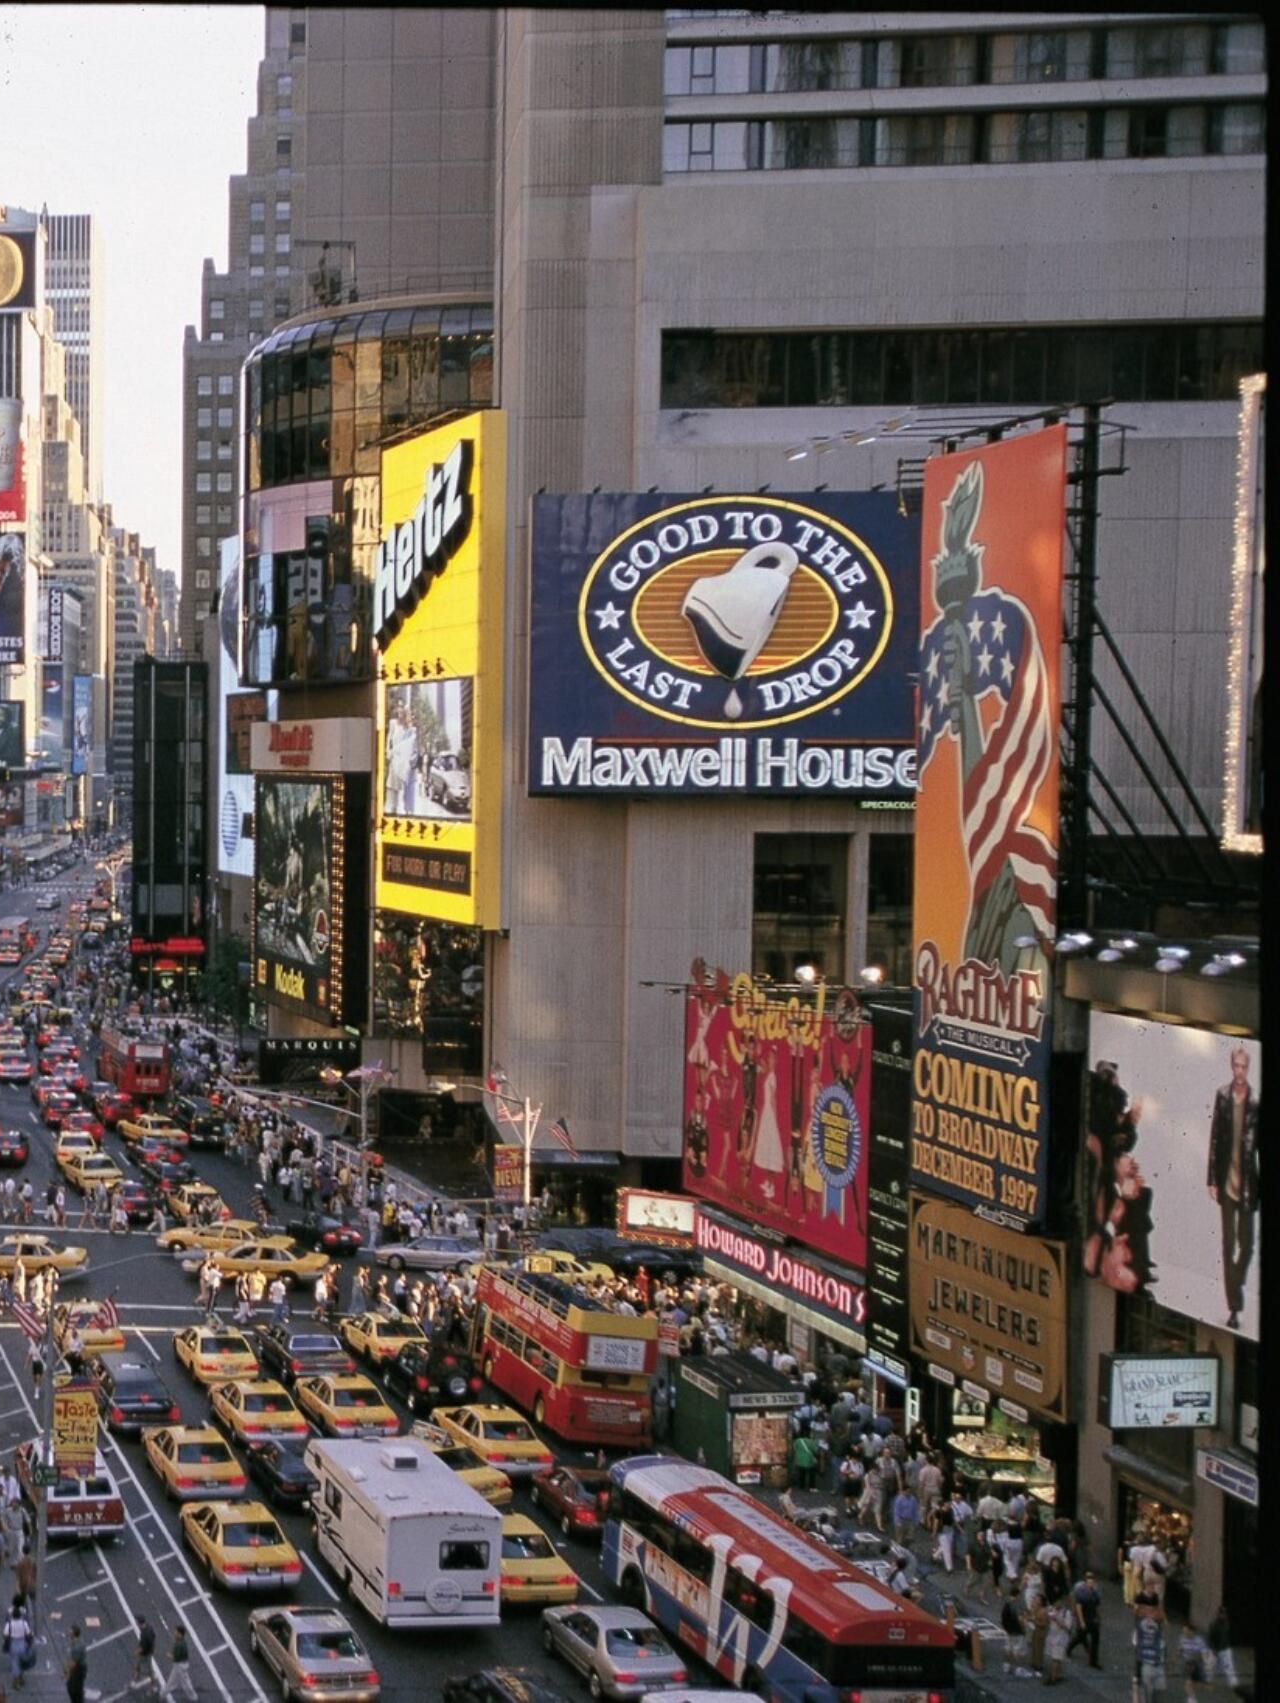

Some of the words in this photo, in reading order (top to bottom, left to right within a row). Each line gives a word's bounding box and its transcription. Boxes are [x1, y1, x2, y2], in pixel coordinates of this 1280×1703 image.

[373, 440, 463, 638] Hertz
[609, 514, 719, 591] GOOD
[724, 512, 782, 544] TO
[793, 520, 868, 594] THE
[605, 638, 701, 710] LAST
[757, 638, 860, 712] DROP
[541, 737, 746, 787] Maxwell
[757, 737, 919, 788] House
[275, 963, 305, 1000] Kodak
[917, 940, 1043, 1037] RAGTIME
[266, 1041, 357, 1050] MARQUIS
[946, 1024, 967, 1043] THE
[969, 1029, 1015, 1056] MUSICAL
[914, 1049, 1040, 1132] COMING
[913, 1101, 935, 1137] TO
[938, 1108, 1039, 1174] BROADWAY
[912, 1139, 995, 1199] DECEMBER
[1000, 1173, 1038, 1214] 1997
[698, 1216, 766, 1271] HOWARD
[766, 1250, 866, 1322] JOHNSON'S
[917, 1222, 1050, 1298] MARTINIQUE
[928, 1277, 1041, 1346] JEWELERS
[63, 1401, 97, 1419] Taste
